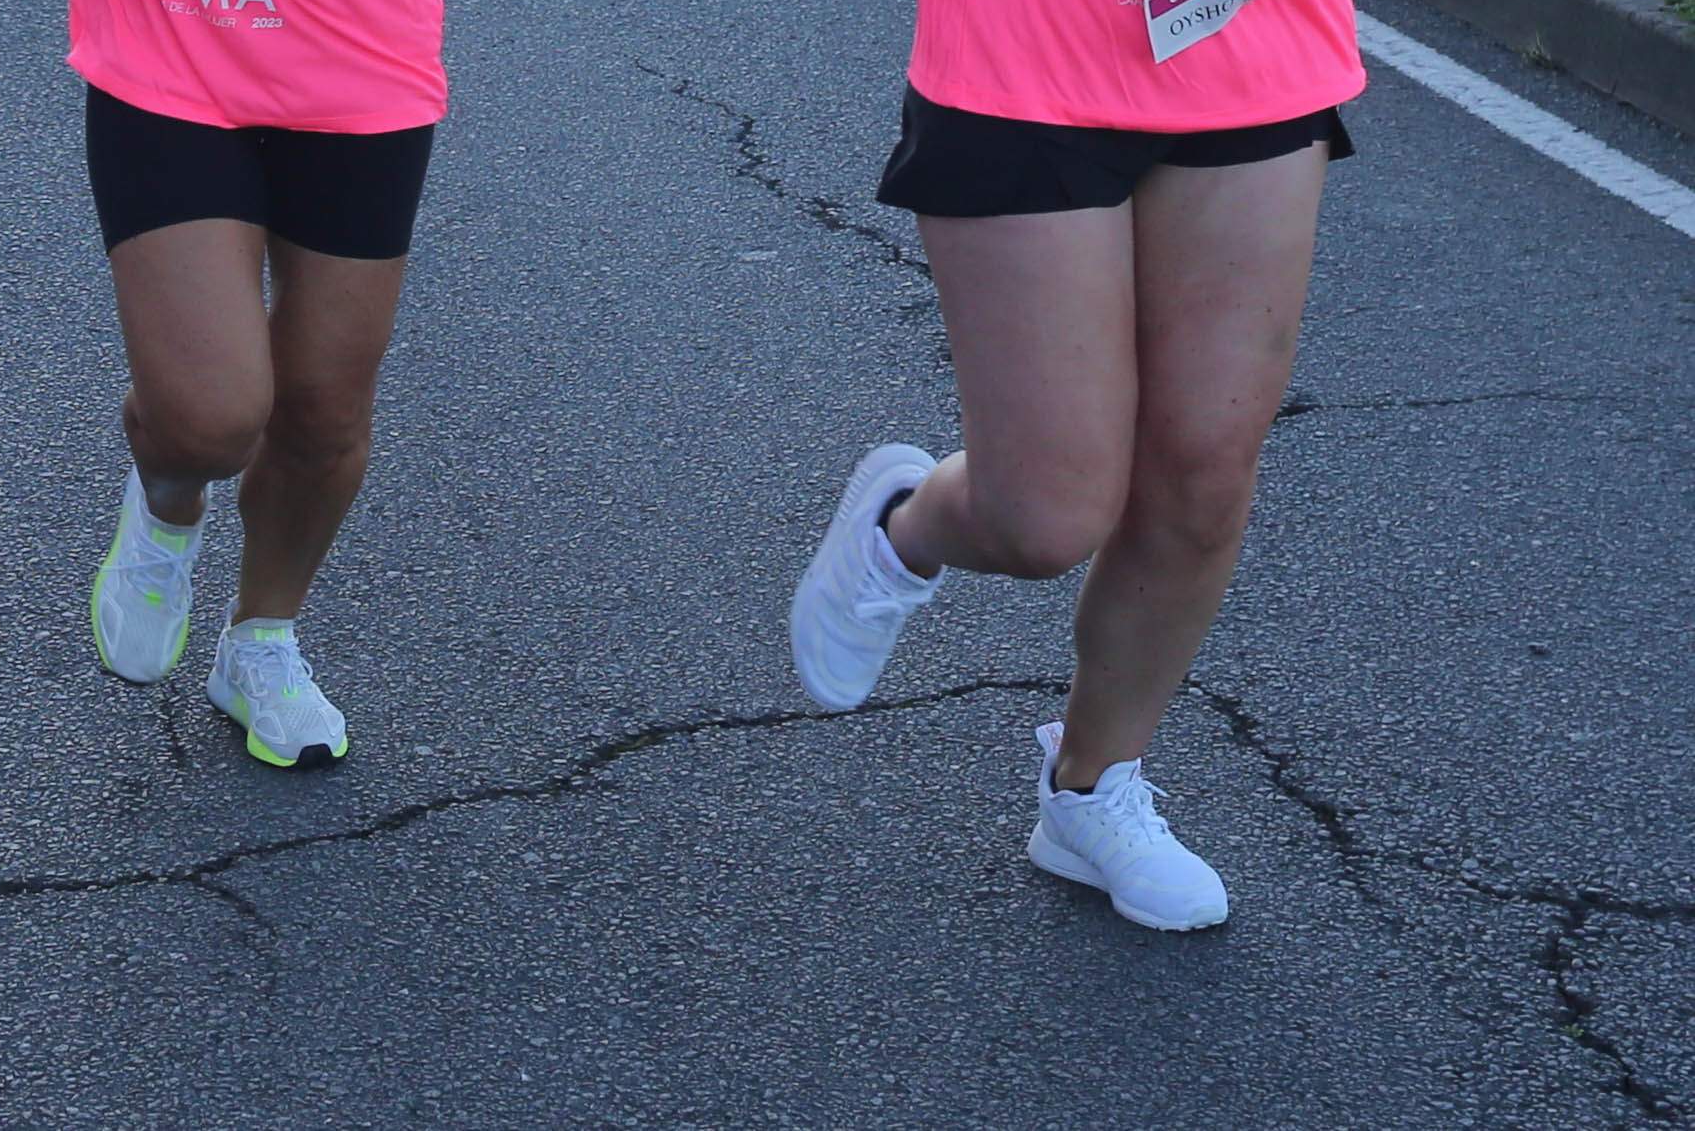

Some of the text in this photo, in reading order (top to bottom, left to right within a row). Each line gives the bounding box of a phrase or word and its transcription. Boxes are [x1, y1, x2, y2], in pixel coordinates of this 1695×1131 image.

[168, 1, 185, 13] DE
[186, 5, 200, 16] LA
[251, 18, 283, 29] 2023
